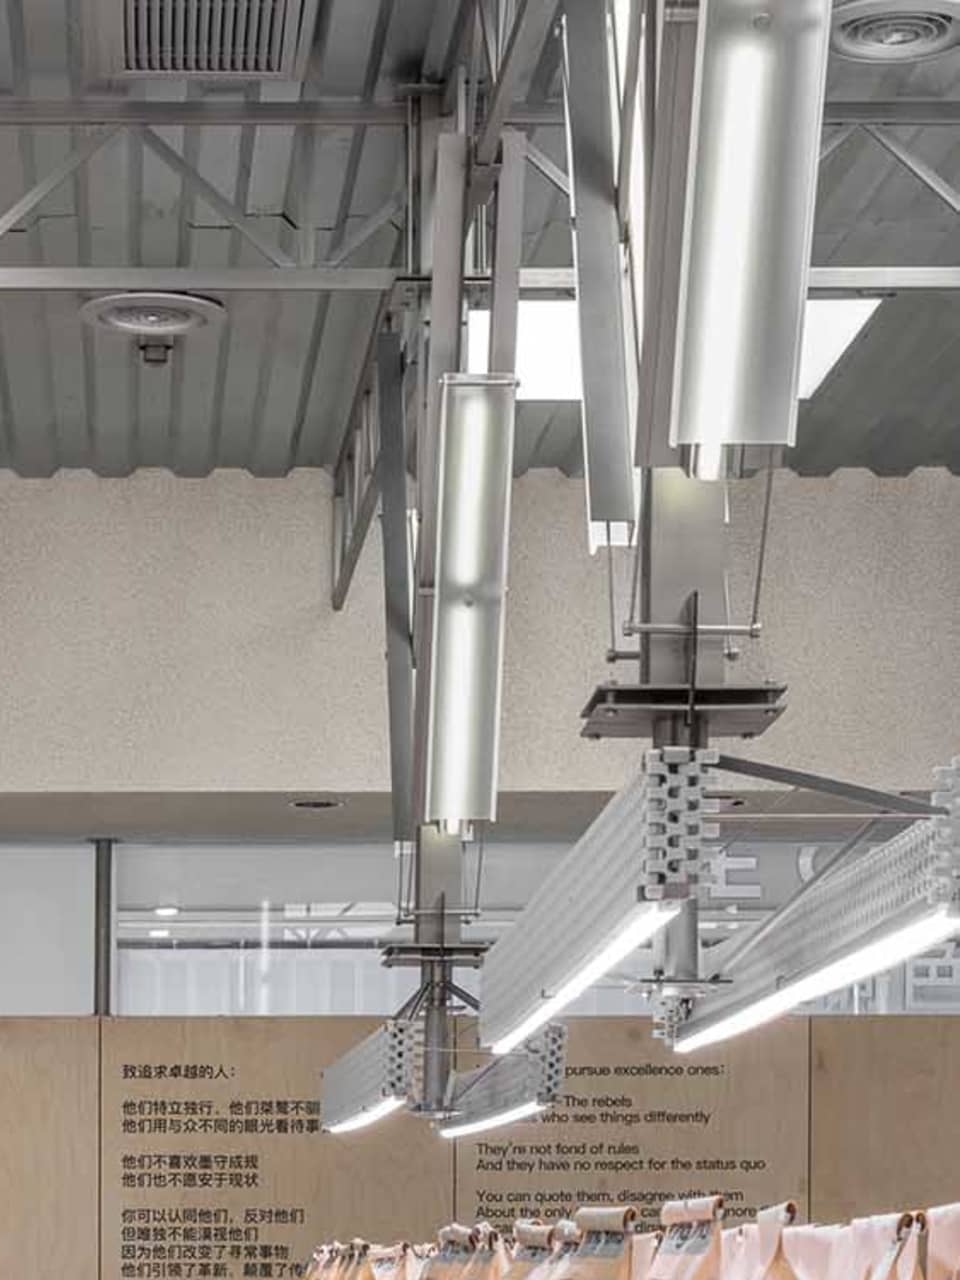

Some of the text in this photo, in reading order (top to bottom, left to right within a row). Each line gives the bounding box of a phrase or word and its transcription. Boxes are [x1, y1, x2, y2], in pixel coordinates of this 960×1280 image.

[565, 1066, 611, 1079] pursue
[614, 1064, 684, 1076] excellence
[592, 1095, 632, 1108] rebels
[542, 1111, 711, 1126] who see things differently
[529, 1144, 552, 1155] not
[556, 1143, 586, 1155] fond
[589, 1143, 604, 1155] of
[607, 1143, 639, 1155] rules
[476, 1159, 766, 1174] And they have no respect for the status quo
[122, 1173, 259, 1188] 他们也不愿安于现状
[476, 1190, 503, 1202] You
[507, 1193, 530, 1202] can
[535, 1191, 572, 1205] quote
[476, 1206, 515, 1218] About
[520, 1206, 541, 1218] the
